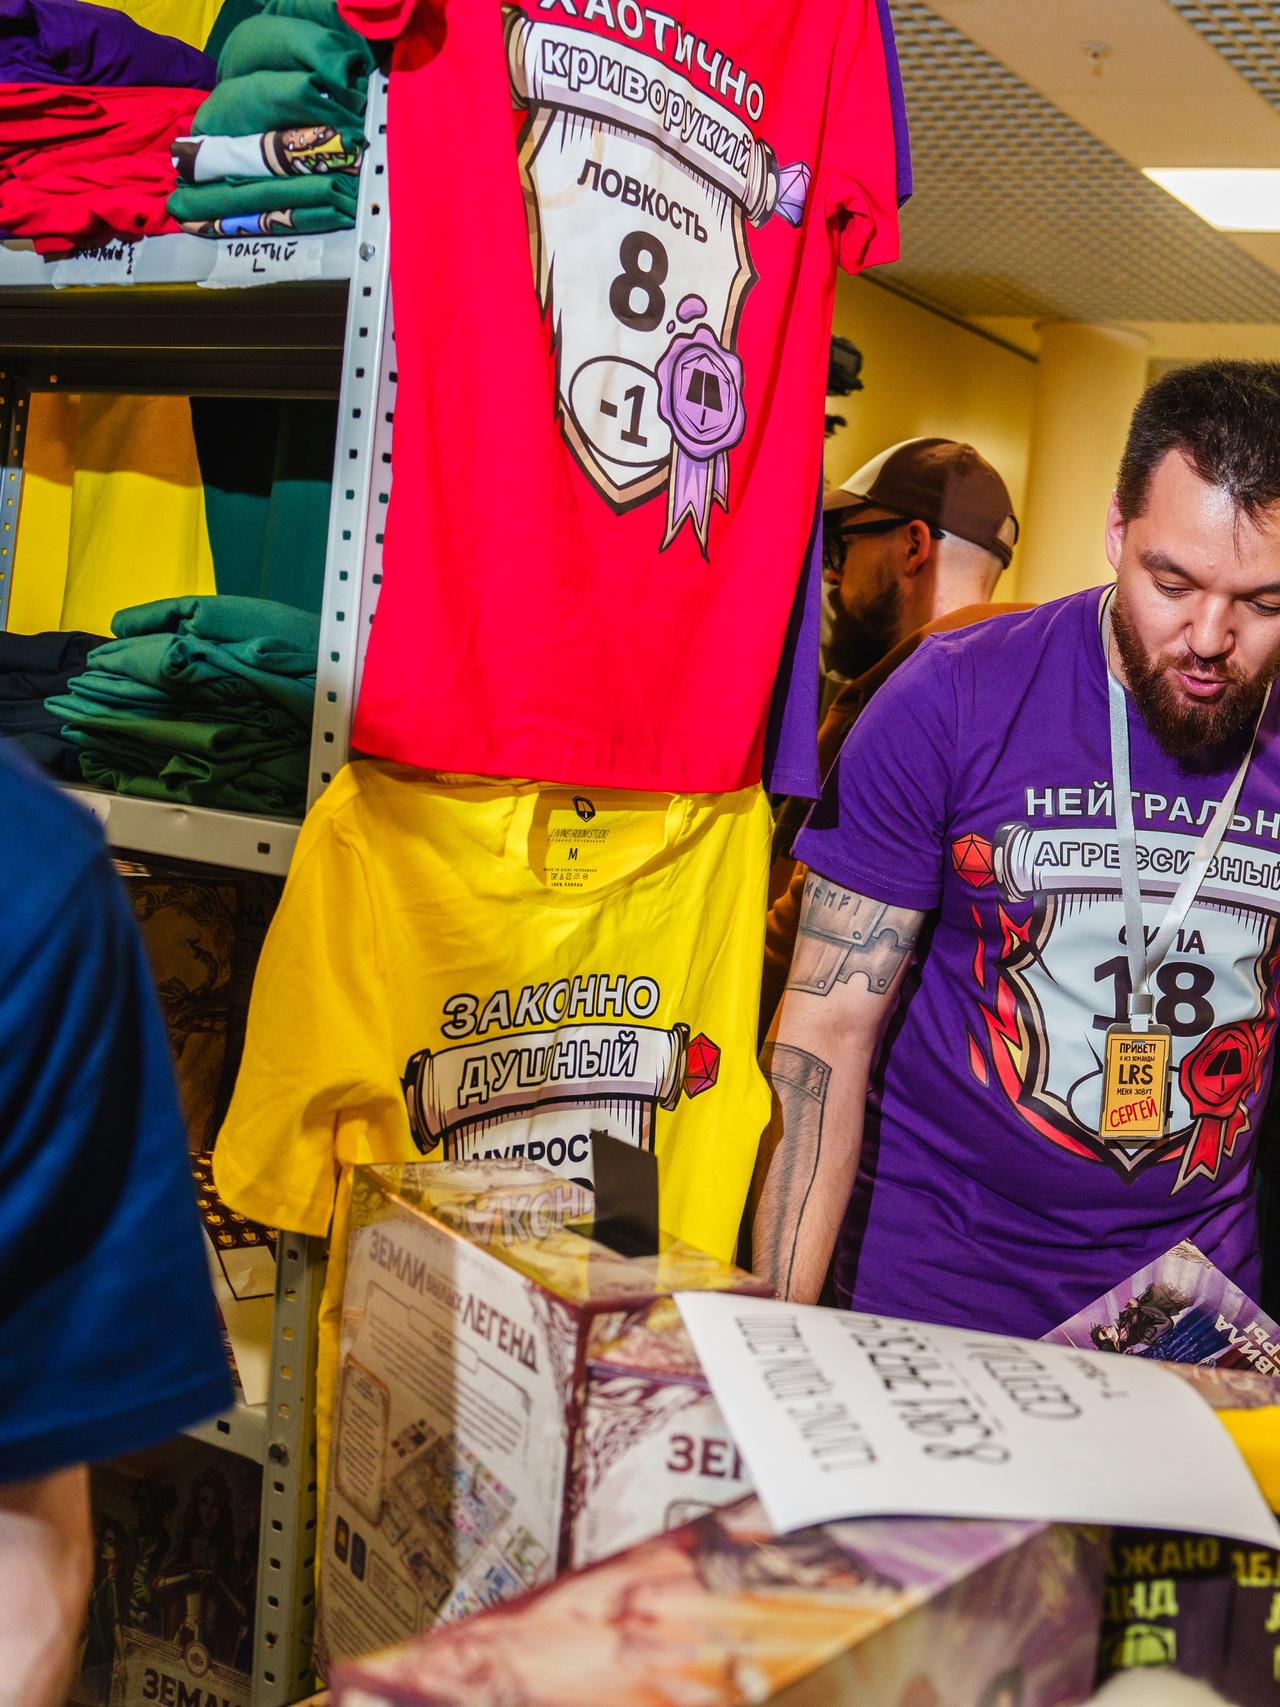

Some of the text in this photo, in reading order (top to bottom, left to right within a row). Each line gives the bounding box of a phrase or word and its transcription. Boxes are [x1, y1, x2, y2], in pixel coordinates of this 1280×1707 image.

[541, 39, 752, 177] криворукий
[577, 158, 708, 243] ЛОВКОСТЬ
[252, 258, 266, 272] L
[609, 230, 669, 332] 8
[599, 384, 648, 448] -1
[568, 847, 578, 861] M
[440, 974, 661, 1040] ЗАКОННО
[1092, 955, 1216, 1038] 18
[457, 1030, 639, 1110] ДУШНЫЙ
[1118, 1064, 1153, 1085] LRS
[1119, 1042, 1156, 1054] ПРИВЕТ!
[1110, 1096, 1158, 1128] СЕРГЕЙ
[1117, 1088, 1152, 1096] МЕНЯ ЗОВУТ
[369, 1229, 427, 1295] ЗЕМЛИ
[463, 1294, 541, 1374] ЛЕГЕНД
[142, 1667, 245, 1707] ЗЕМ
